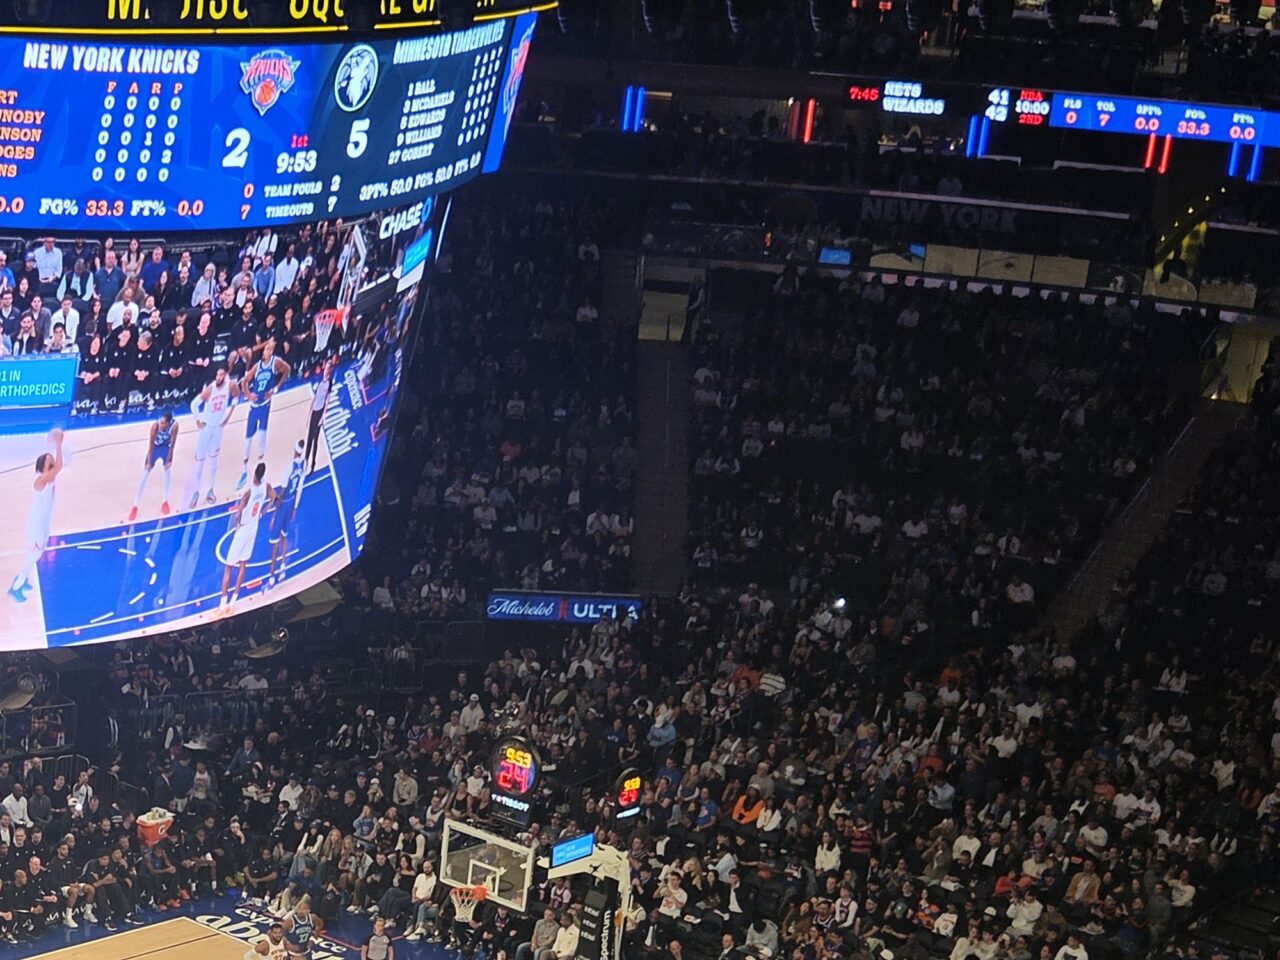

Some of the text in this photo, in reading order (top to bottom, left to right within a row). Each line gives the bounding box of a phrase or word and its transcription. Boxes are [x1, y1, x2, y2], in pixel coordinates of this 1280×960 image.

[23, 42, 200, 75] NEW YORK KNICKS
[107, 81, 183, 95] F A R P
[849, 86, 879, 101] 7:45
[884, 81, 922, 98] NETS
[988, 88, 1010, 105] 41
[1020, 90, 1043, 101] NBA
[883, 97, 945, 115] WIZARDS
[985, 105, 1008, 122] 42
[1015, 100, 1050, 115] 10:00
[1019, 114, 1043, 124] 2ND
[1066, 112, 1255, 140] 0 7 0.0 33.3 0.0
[221, 127, 251, 168] 2
[291, 135, 309, 148] 1st
[346, 118, 370, 159] 5
[276, 150, 317, 173] 9:53
[243, 175, 341, 198] 0 TEAM FOULS 2
[39, 198, 78, 216] FG%
[85, 199, 124, 216] 33.3
[130, 200, 166, 217] FT%
[177, 200, 204, 217] 0.0
[240, 196, 338, 220] 7 TIMEOUTS 7
[862, 198, 1018, 232] NEW YORK
[379, 201, 423, 240] CHASE
[9, 370, 21, 382] IN
[487, 598, 554, 616] Michelob
[498, 760, 529, 794] 24
